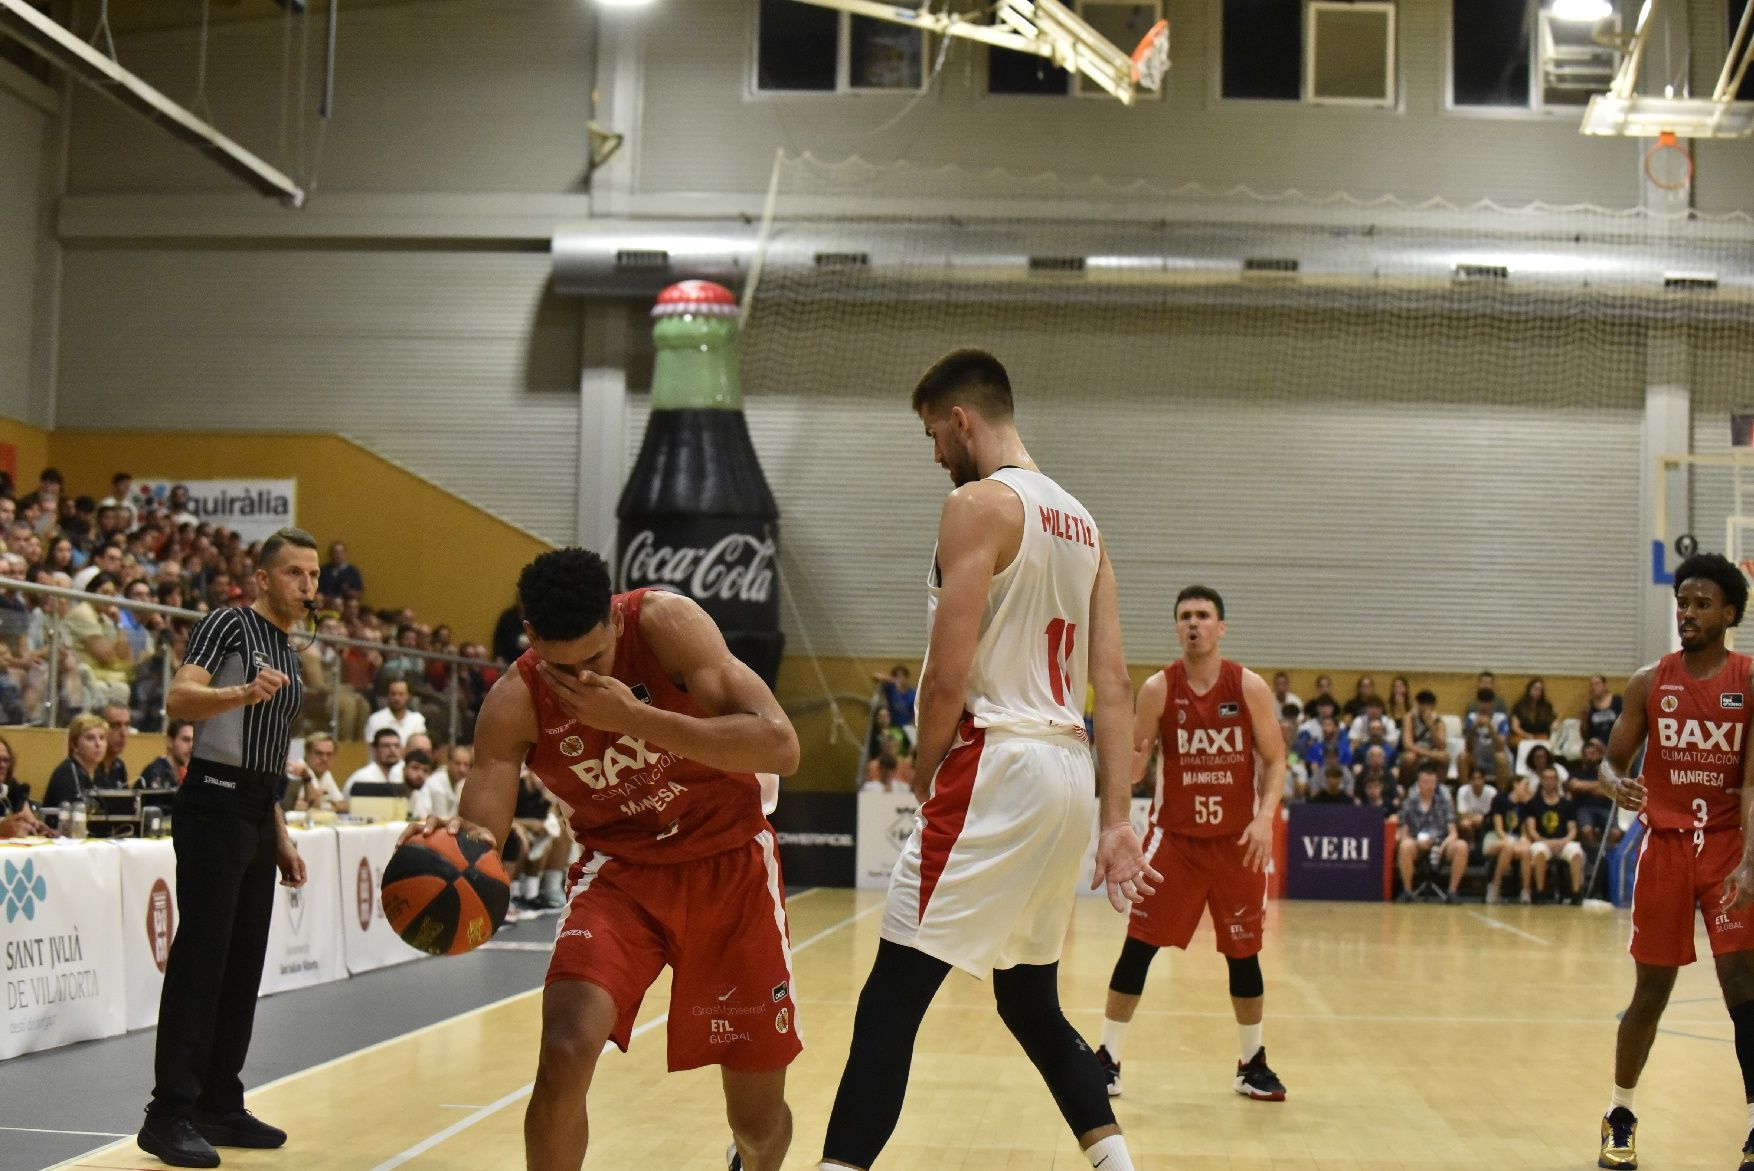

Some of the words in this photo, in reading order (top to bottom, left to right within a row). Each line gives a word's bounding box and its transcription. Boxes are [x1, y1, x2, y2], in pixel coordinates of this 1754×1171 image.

[621, 530, 775, 602] Coca-Cola
[1177, 726, 1243, 755] BAXI
[1658, 718, 1743, 752] BAXI
[568, 735, 661, 790] BAX
[1661, 750, 1739, 766] CLIMATIZACIÓN
[1183, 771, 1233, 785] MANRESA
[1670, 769, 1724, 787] MANRESA
[1195, 795, 1223, 825] 55
[1692, 798, 1708, 828] 3
[1303, 835, 1370, 861] VERI
[1715, 914, 1730, 925] ETL
[6, 937, 44, 971] SANT
[8, 979, 29, 1010] DE
[711, 1019, 734, 1032] ETL
